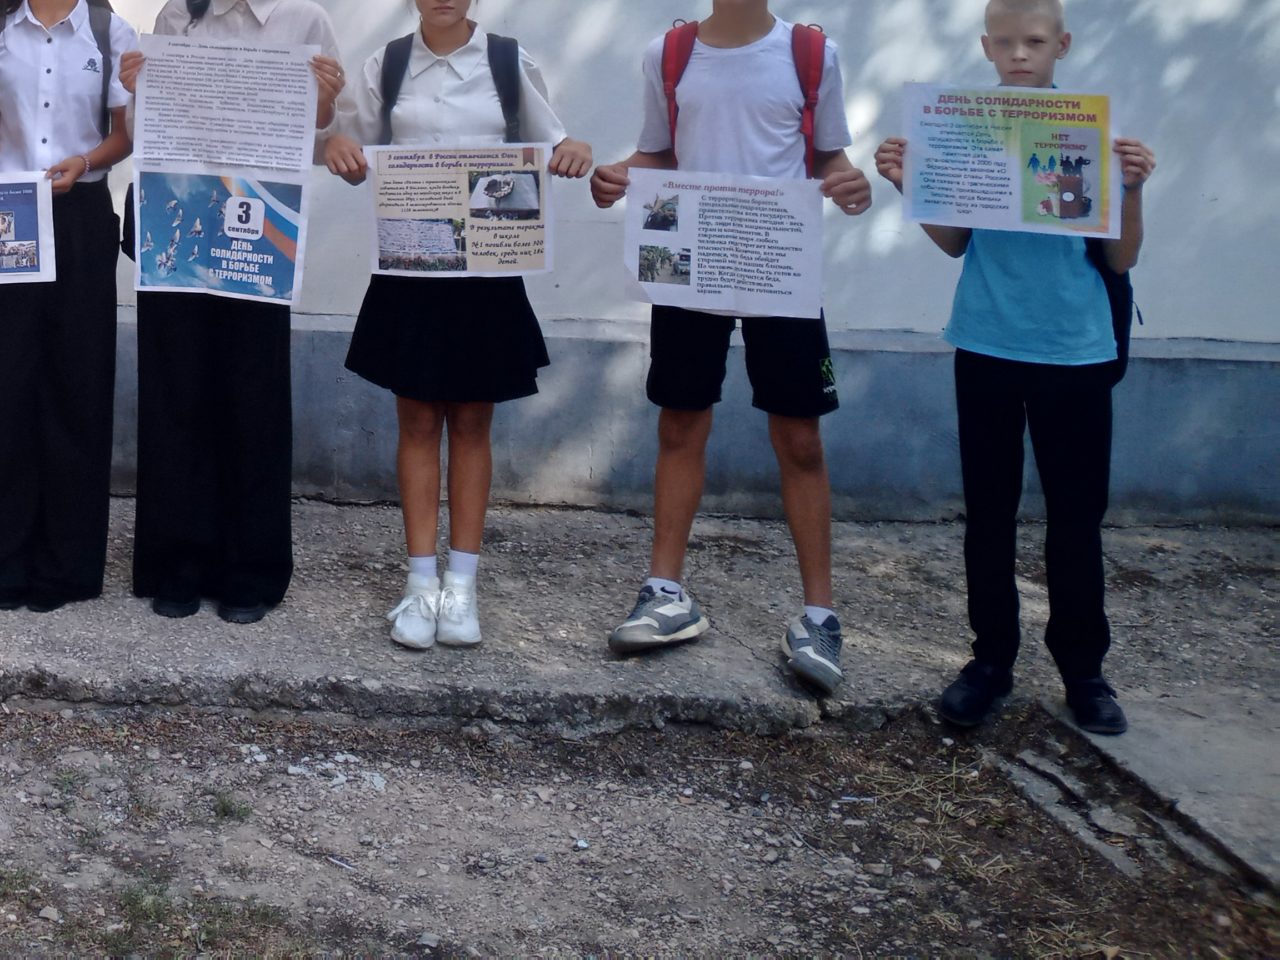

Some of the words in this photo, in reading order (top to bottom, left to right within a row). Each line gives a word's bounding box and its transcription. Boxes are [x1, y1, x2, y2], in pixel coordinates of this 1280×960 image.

[937, 94, 971, 104] ДЕНЬ
[975, 96, 1081, 110] СОЛИДАРНОСТИ
[923, 105, 931, 114] В
[934, 106, 984, 117] БОРЬБЕ
[988, 109, 997, 117] С
[1000, 109, 1097, 123] ТЕРРОРИЗМОМ
[1051, 133, 1071, 142] НЕТ
[393, 153, 425, 162] сентября
[662, 181, 702, 191] «Вместе
[703, 183, 737, 193] против
[738, 186, 784, 197] террора!»
[237, 201, 252, 225] 3
[227, 226, 259, 235] сентября
[476, 224, 515, 233] результате
[231, 240, 253, 252] ДЕНЬ
[485, 240, 512, 248] погибли
[513, 240, 531, 248] более
[210, 247, 274, 265] СОЛИДАРНОСТИ
[221, 259, 228, 269] В
[228, 261, 260, 273] БОРЬБЕ
[208, 268, 215, 277] С
[215, 269, 273, 285] ТЕРРОРИЗМОМ
